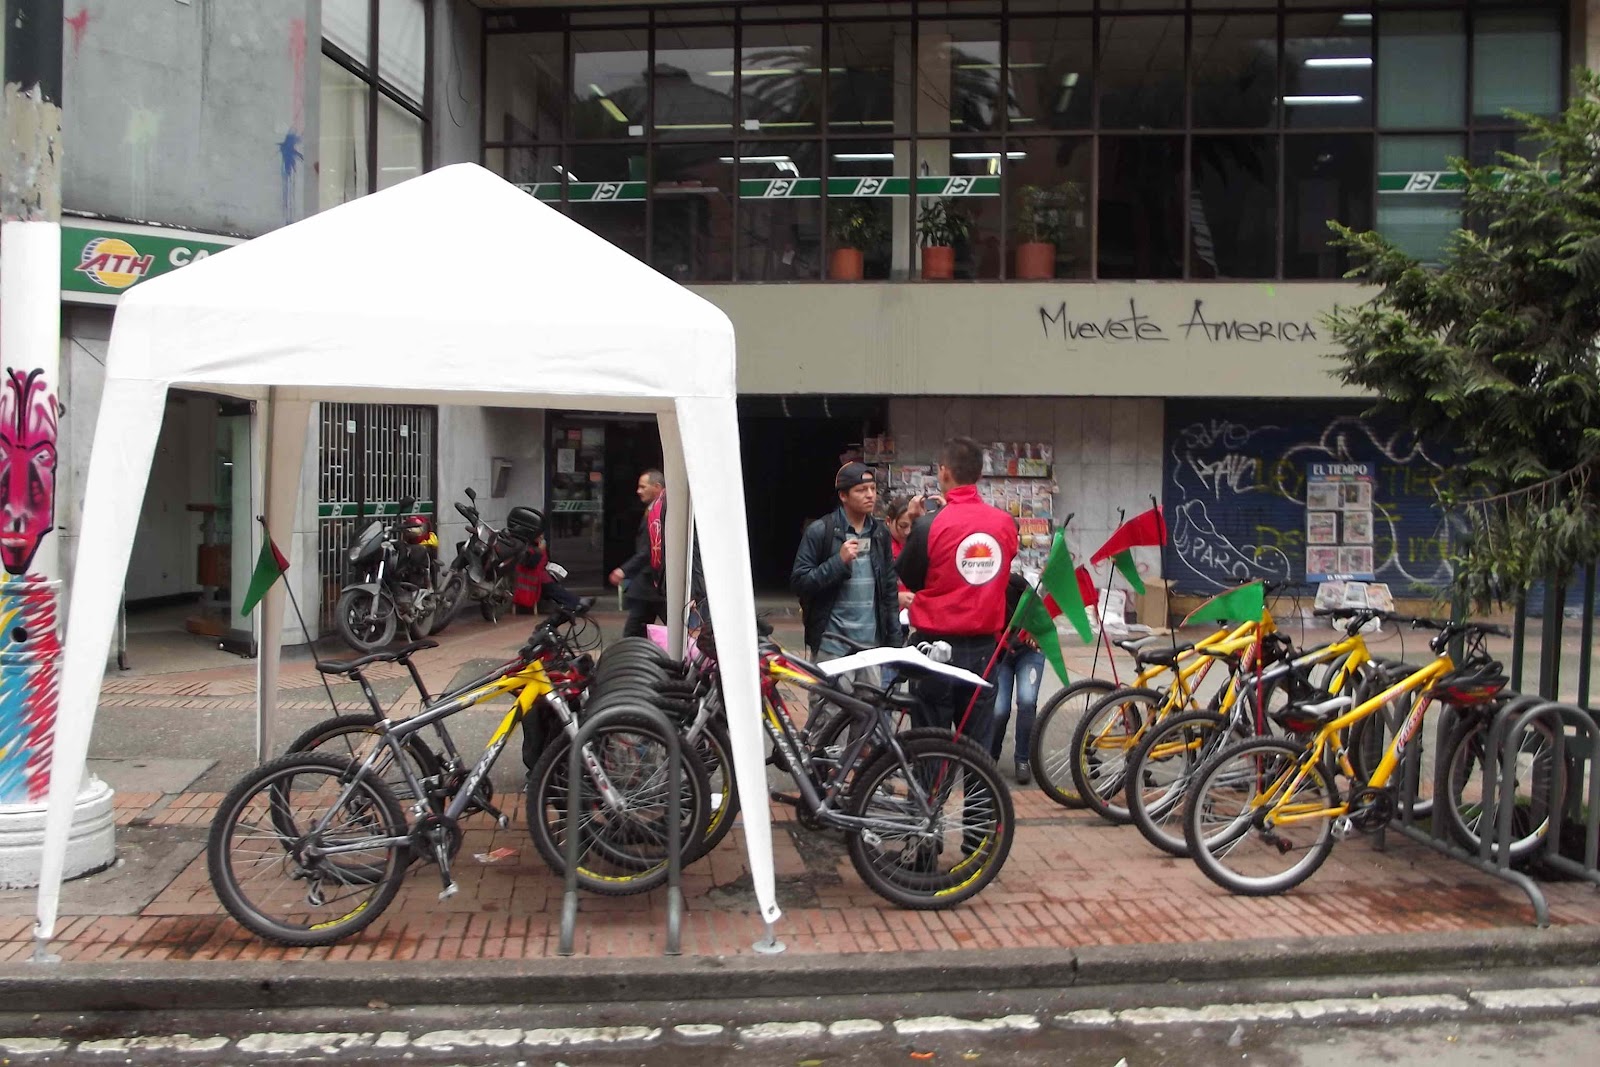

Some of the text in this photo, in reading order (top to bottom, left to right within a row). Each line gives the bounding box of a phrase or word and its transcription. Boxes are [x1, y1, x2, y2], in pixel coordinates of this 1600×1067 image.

[76, 252, 153, 275] ATH
[1313, 464, 1368, 475] EL TIEMPO
[961, 560, 995, 568] Porvenir
[1192, 537, 1250, 579] PARO
